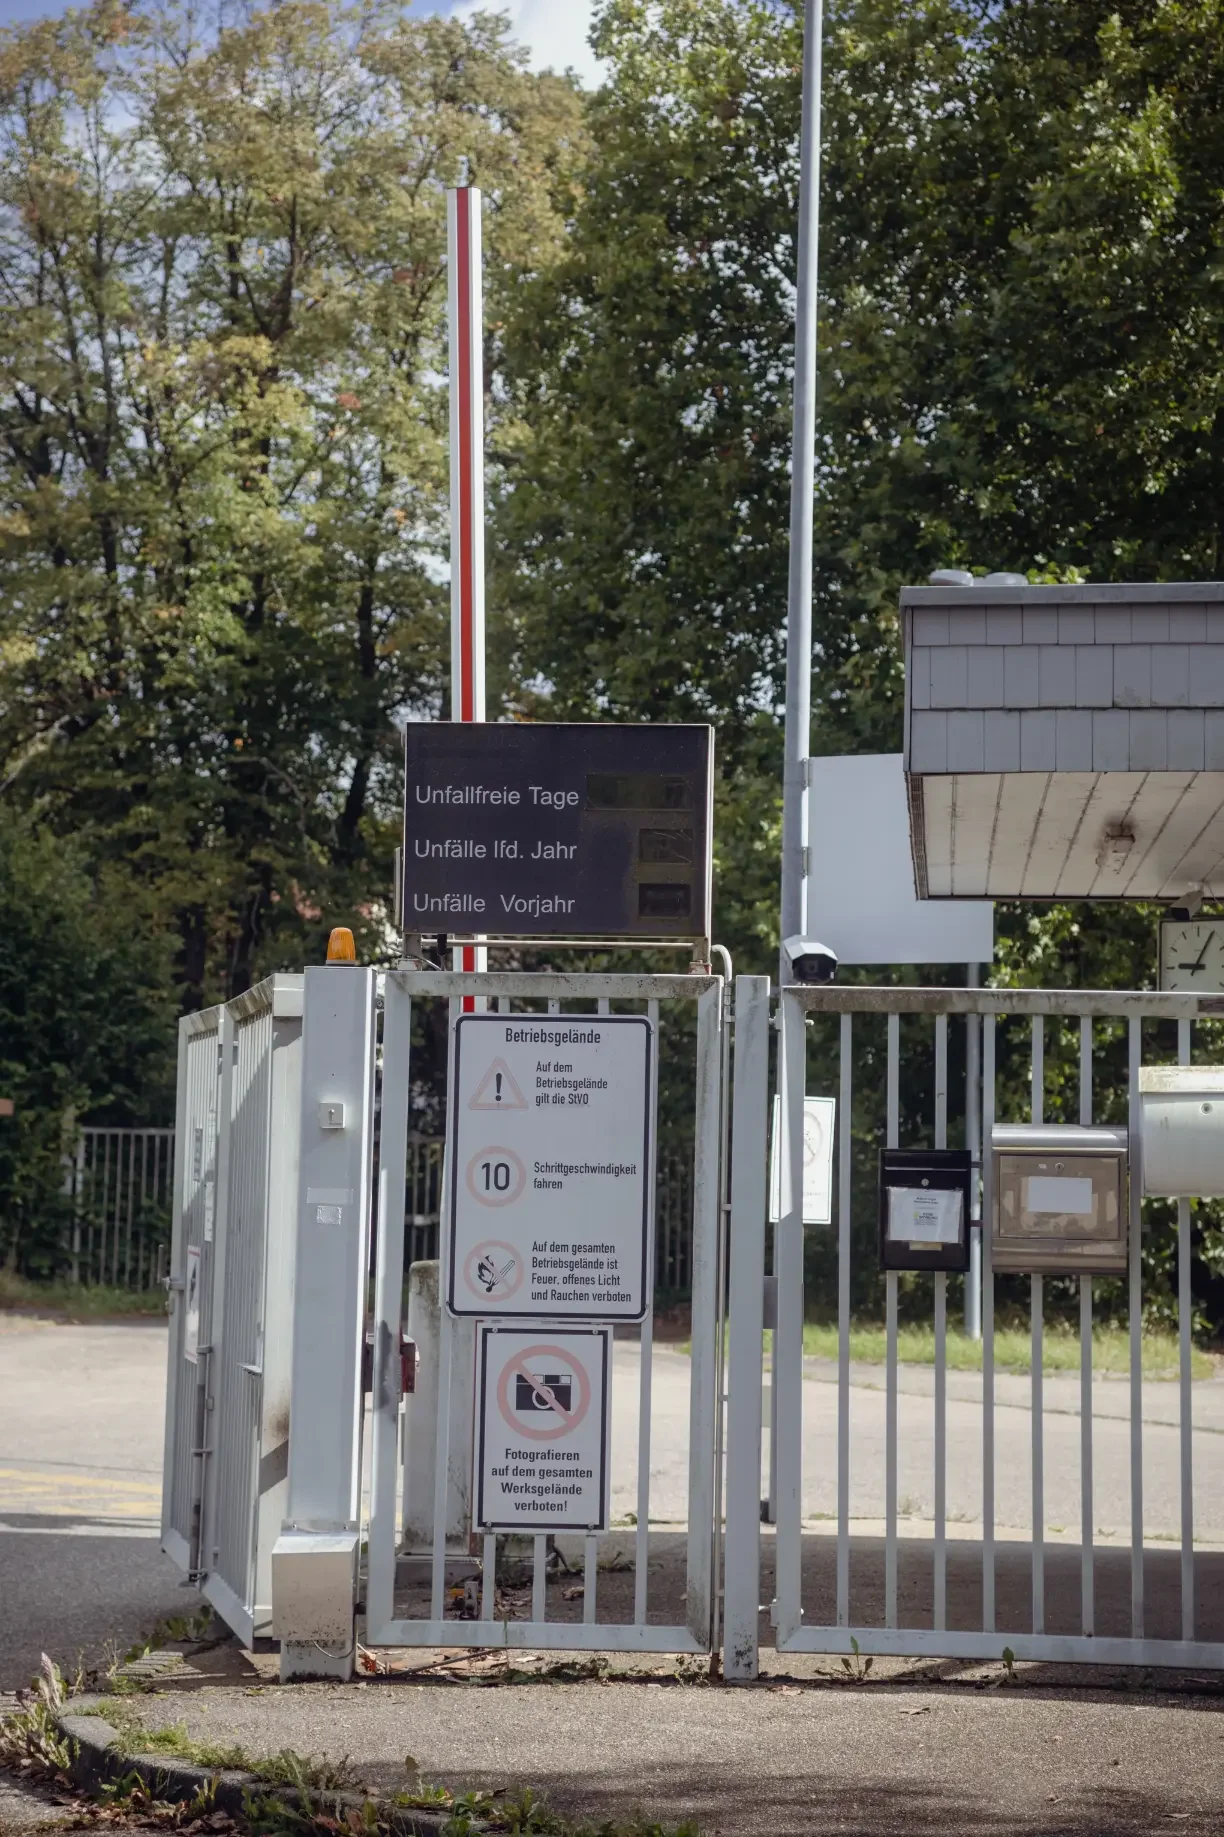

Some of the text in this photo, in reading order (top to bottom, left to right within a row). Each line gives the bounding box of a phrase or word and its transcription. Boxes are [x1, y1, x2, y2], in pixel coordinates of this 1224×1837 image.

[415, 785, 579, 810] Unfallfreie Tage
[414, 839, 577, 859] Unfälle lfd. Jahr
[413, 893, 576, 917] Unfälle Vorjahr
[505, 1027, 601, 1047] Betriebsgelände
[536, 1061, 573, 1073] Auf dem
[535, 1077, 608, 1092] Betriebsgelände
[535, 1093, 589, 1107] gilt die StVO
[534, 1161, 637, 1177] Schrittgeschwindigkeit
[481, 1162, 510, 1191] 10
[533, 1177, 563, 1190] fahren
[532, 1241, 616, 1256] Auf dem gesamten
[532, 1256, 618, 1272] Betriebsgelände ist
[562, 1274, 596, 1285] offenes
[598, 1275, 621, 1286] Licht
[531, 1289, 632, 1303] und Rauchen verboten
[505, 1448, 580, 1462] Fotografieren
[491, 1465, 593, 1479] auf dem gesamten
[501, 1482, 583, 1496] Werksgelände
[514, 1500, 568, 1512] verboten!
